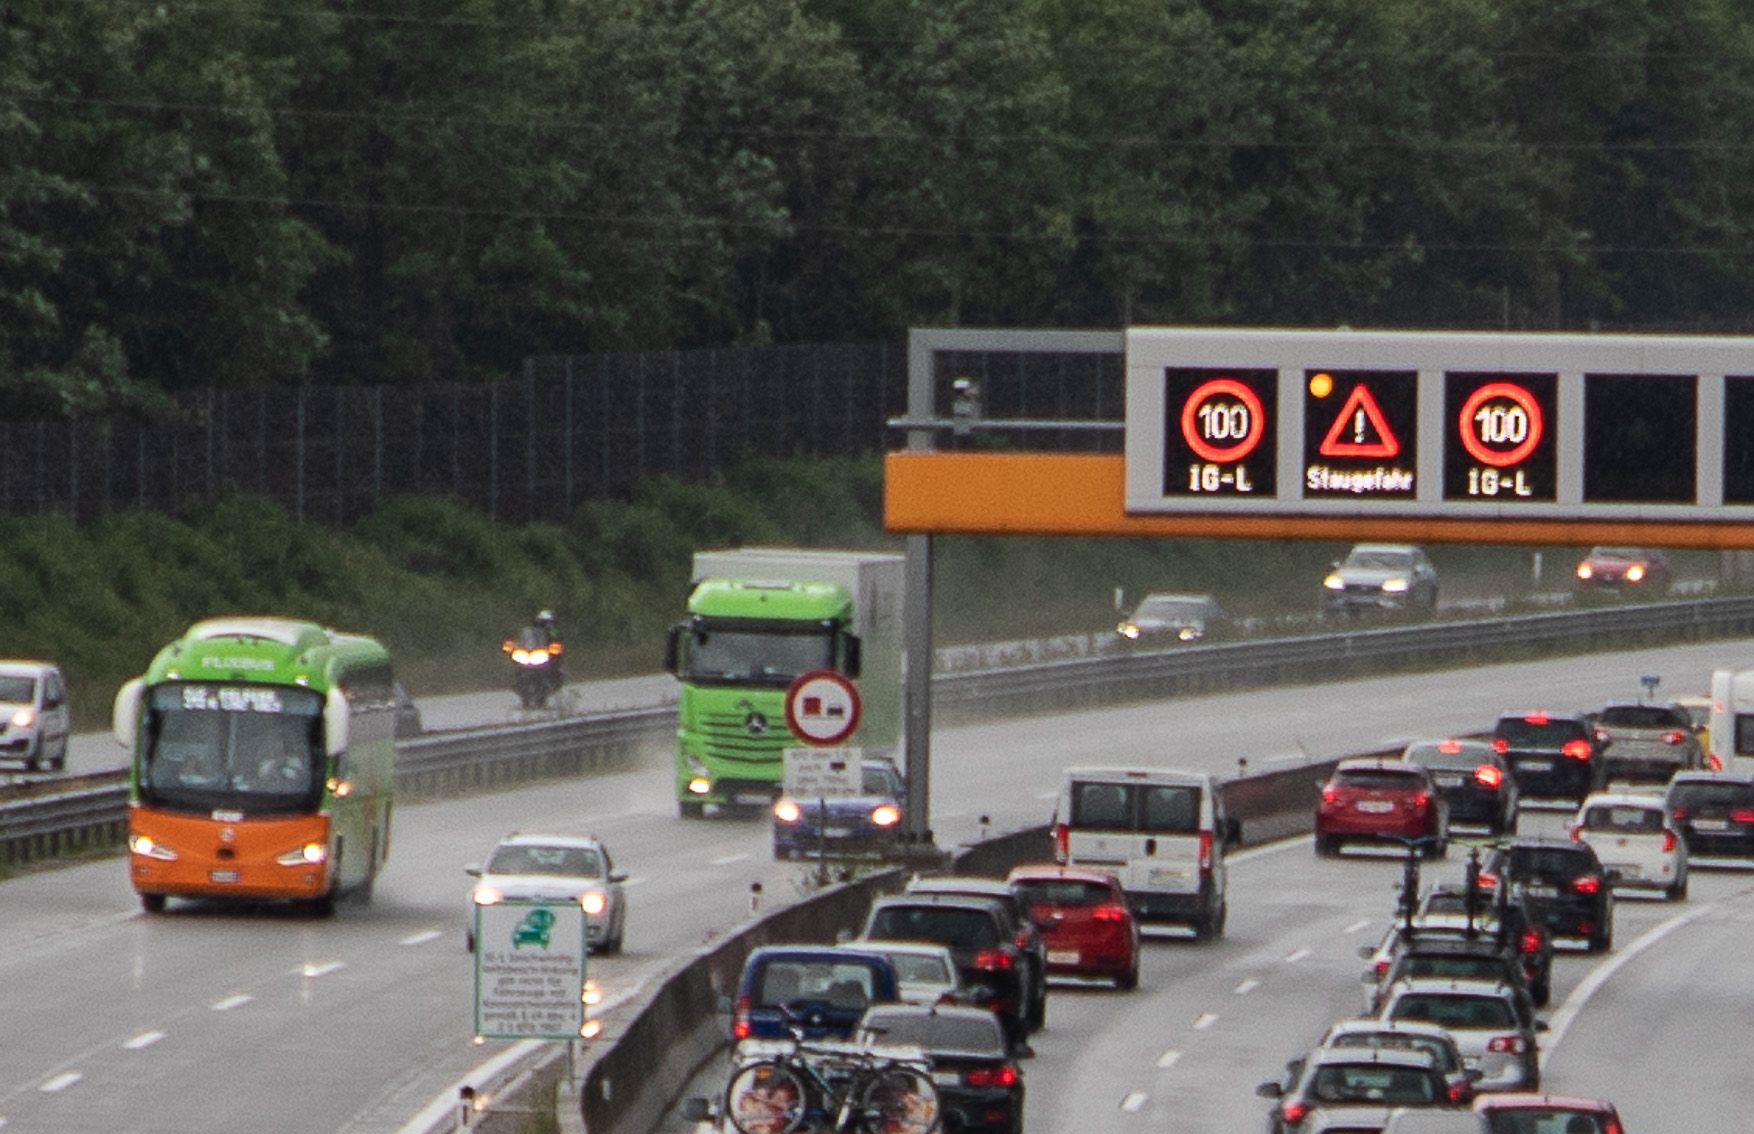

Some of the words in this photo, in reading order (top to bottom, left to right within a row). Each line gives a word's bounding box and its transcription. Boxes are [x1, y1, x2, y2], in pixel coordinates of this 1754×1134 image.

[1199, 402, 1249, 440] 100
[1475, 405, 1528, 444] 100
[1189, 464, 1253, 493] IG-L
[1306, 466, 1414, 494] Staugefahr
[1467, 467, 1533, 497] IG-L
